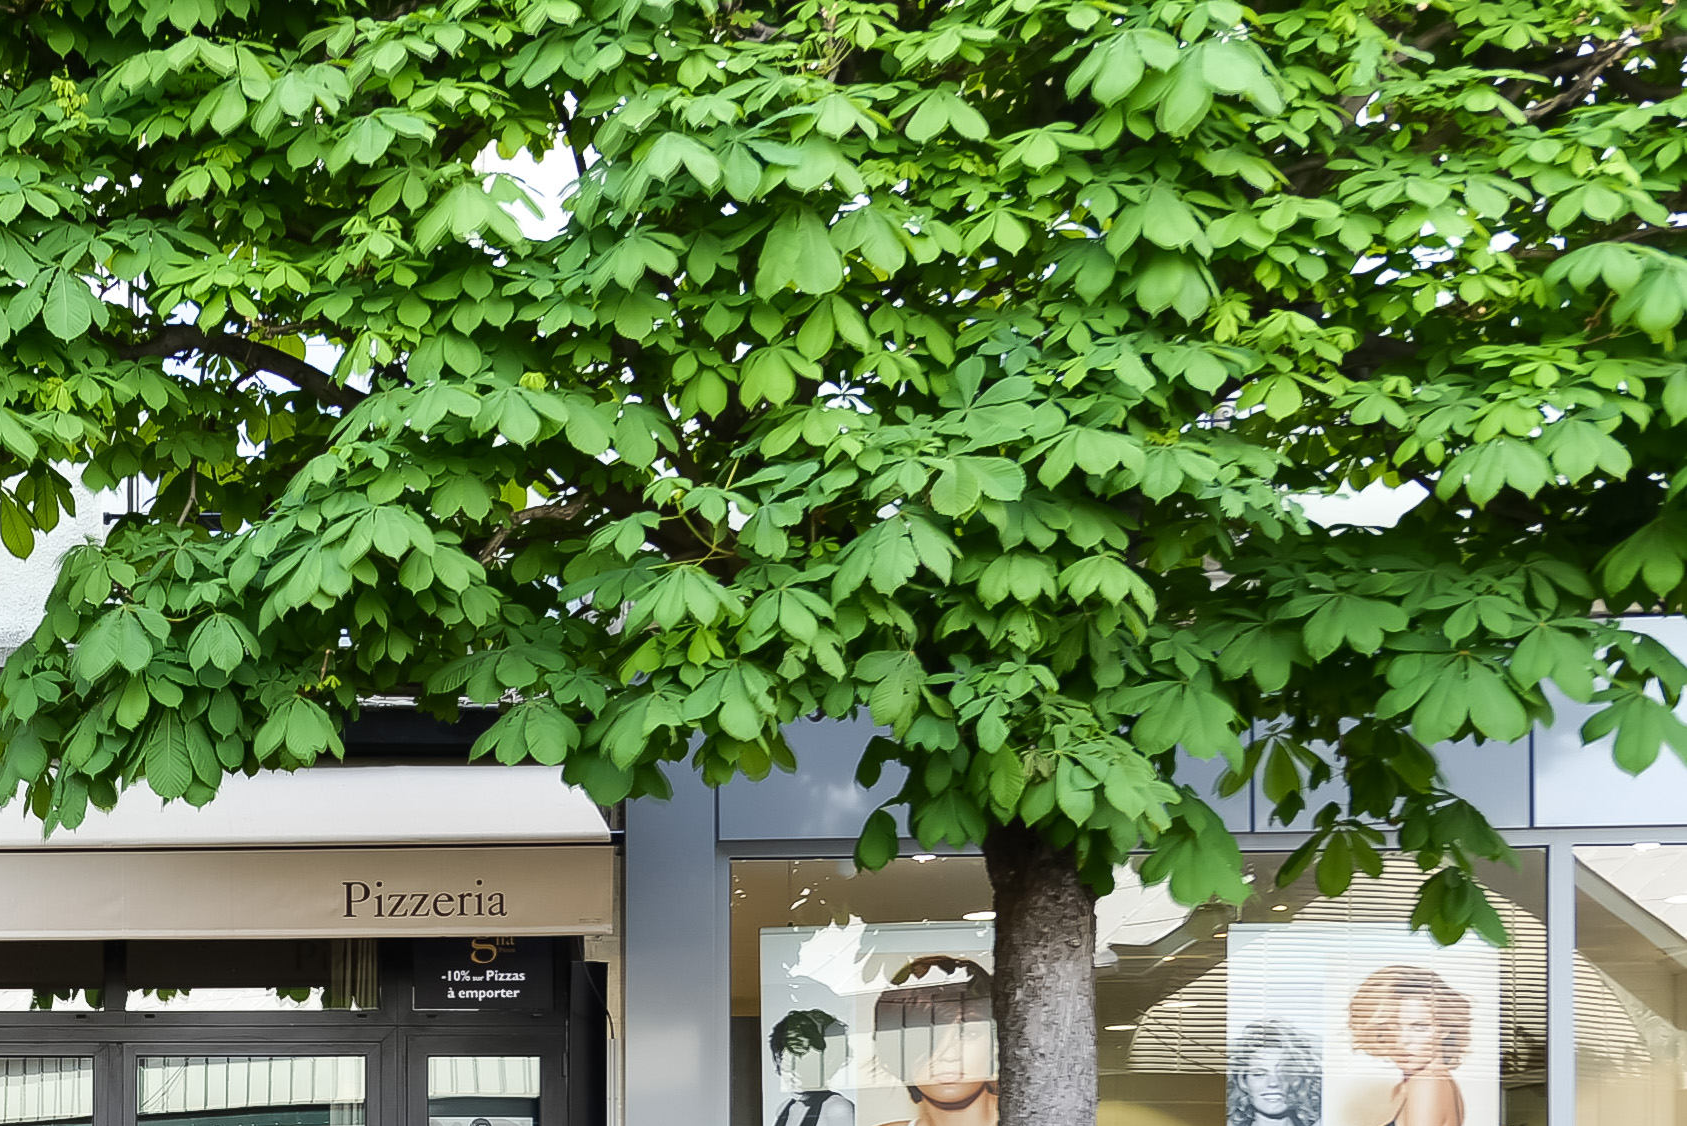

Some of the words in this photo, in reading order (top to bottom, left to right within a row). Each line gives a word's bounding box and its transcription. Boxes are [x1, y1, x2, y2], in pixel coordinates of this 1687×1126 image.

[341, 879, 508, 918] Pizzeria
[441, 970, 471, 982] -10%
[485, 970, 526, 982] Pizzas
[447, 987, 456, 999] à
[458, 988, 521, 1002] emporter
